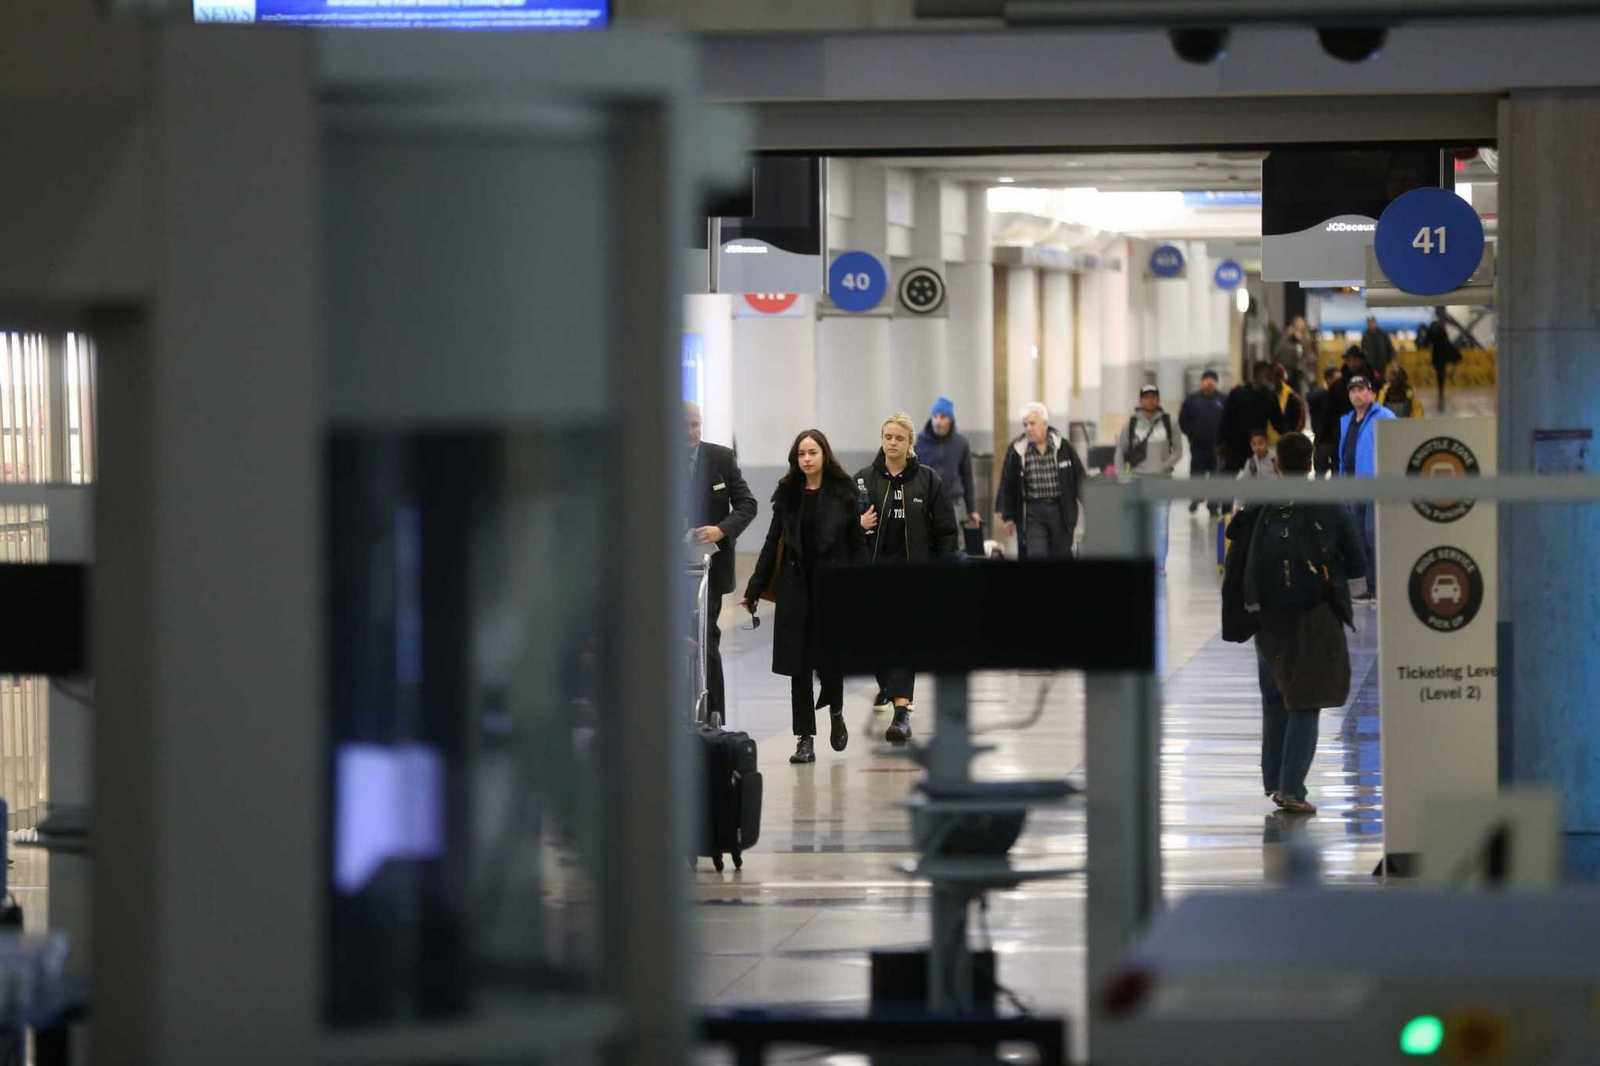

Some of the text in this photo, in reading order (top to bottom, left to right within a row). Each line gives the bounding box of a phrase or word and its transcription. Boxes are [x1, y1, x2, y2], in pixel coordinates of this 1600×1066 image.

[1325, 222, 1375, 232] JCDecaux
[1412, 226, 1446, 254] 41
[841, 272, 870, 290] 40
[1396, 664, 1498, 681] Ticketing Leve
[1420, 685, 1481, 702] (Level 2)
